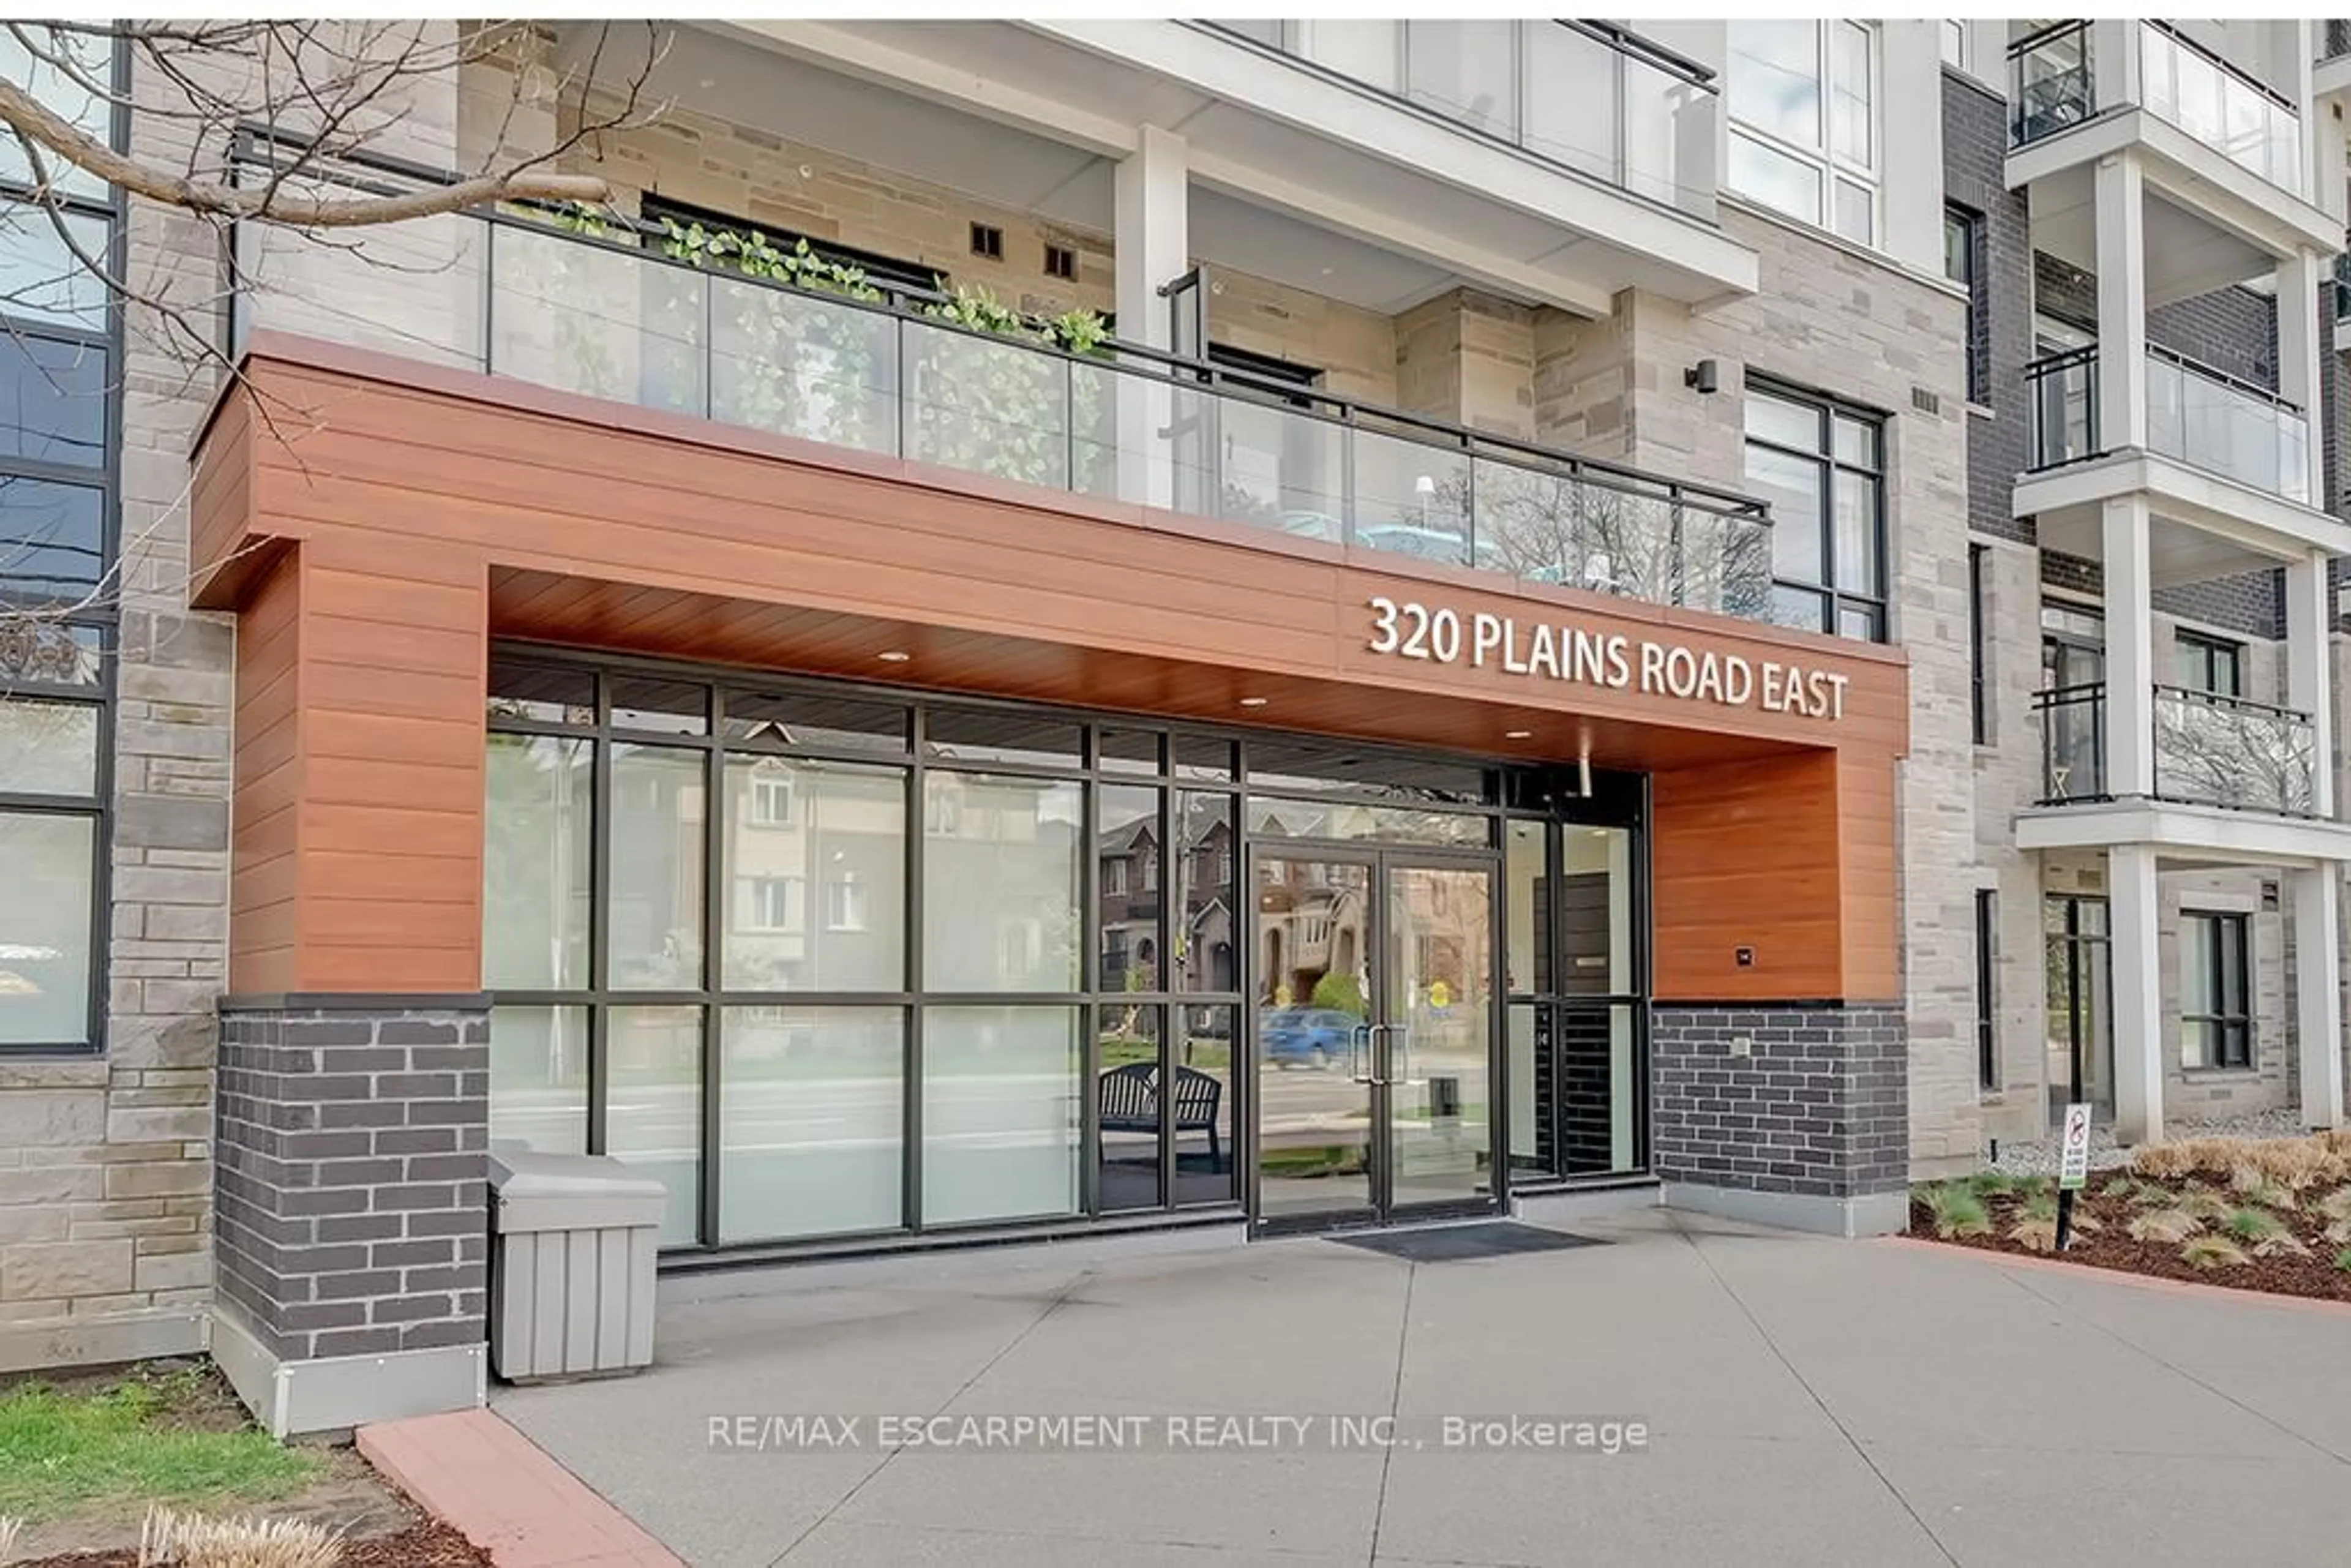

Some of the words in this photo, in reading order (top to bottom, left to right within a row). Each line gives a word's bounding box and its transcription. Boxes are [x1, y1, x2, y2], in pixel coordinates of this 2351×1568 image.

[1367, 597, 1459, 662] 320
[1471, 613, 1630, 688] PLAINS
[1641, 643, 1752, 704] ROAD
[1763, 662, 1848, 719] EAST
